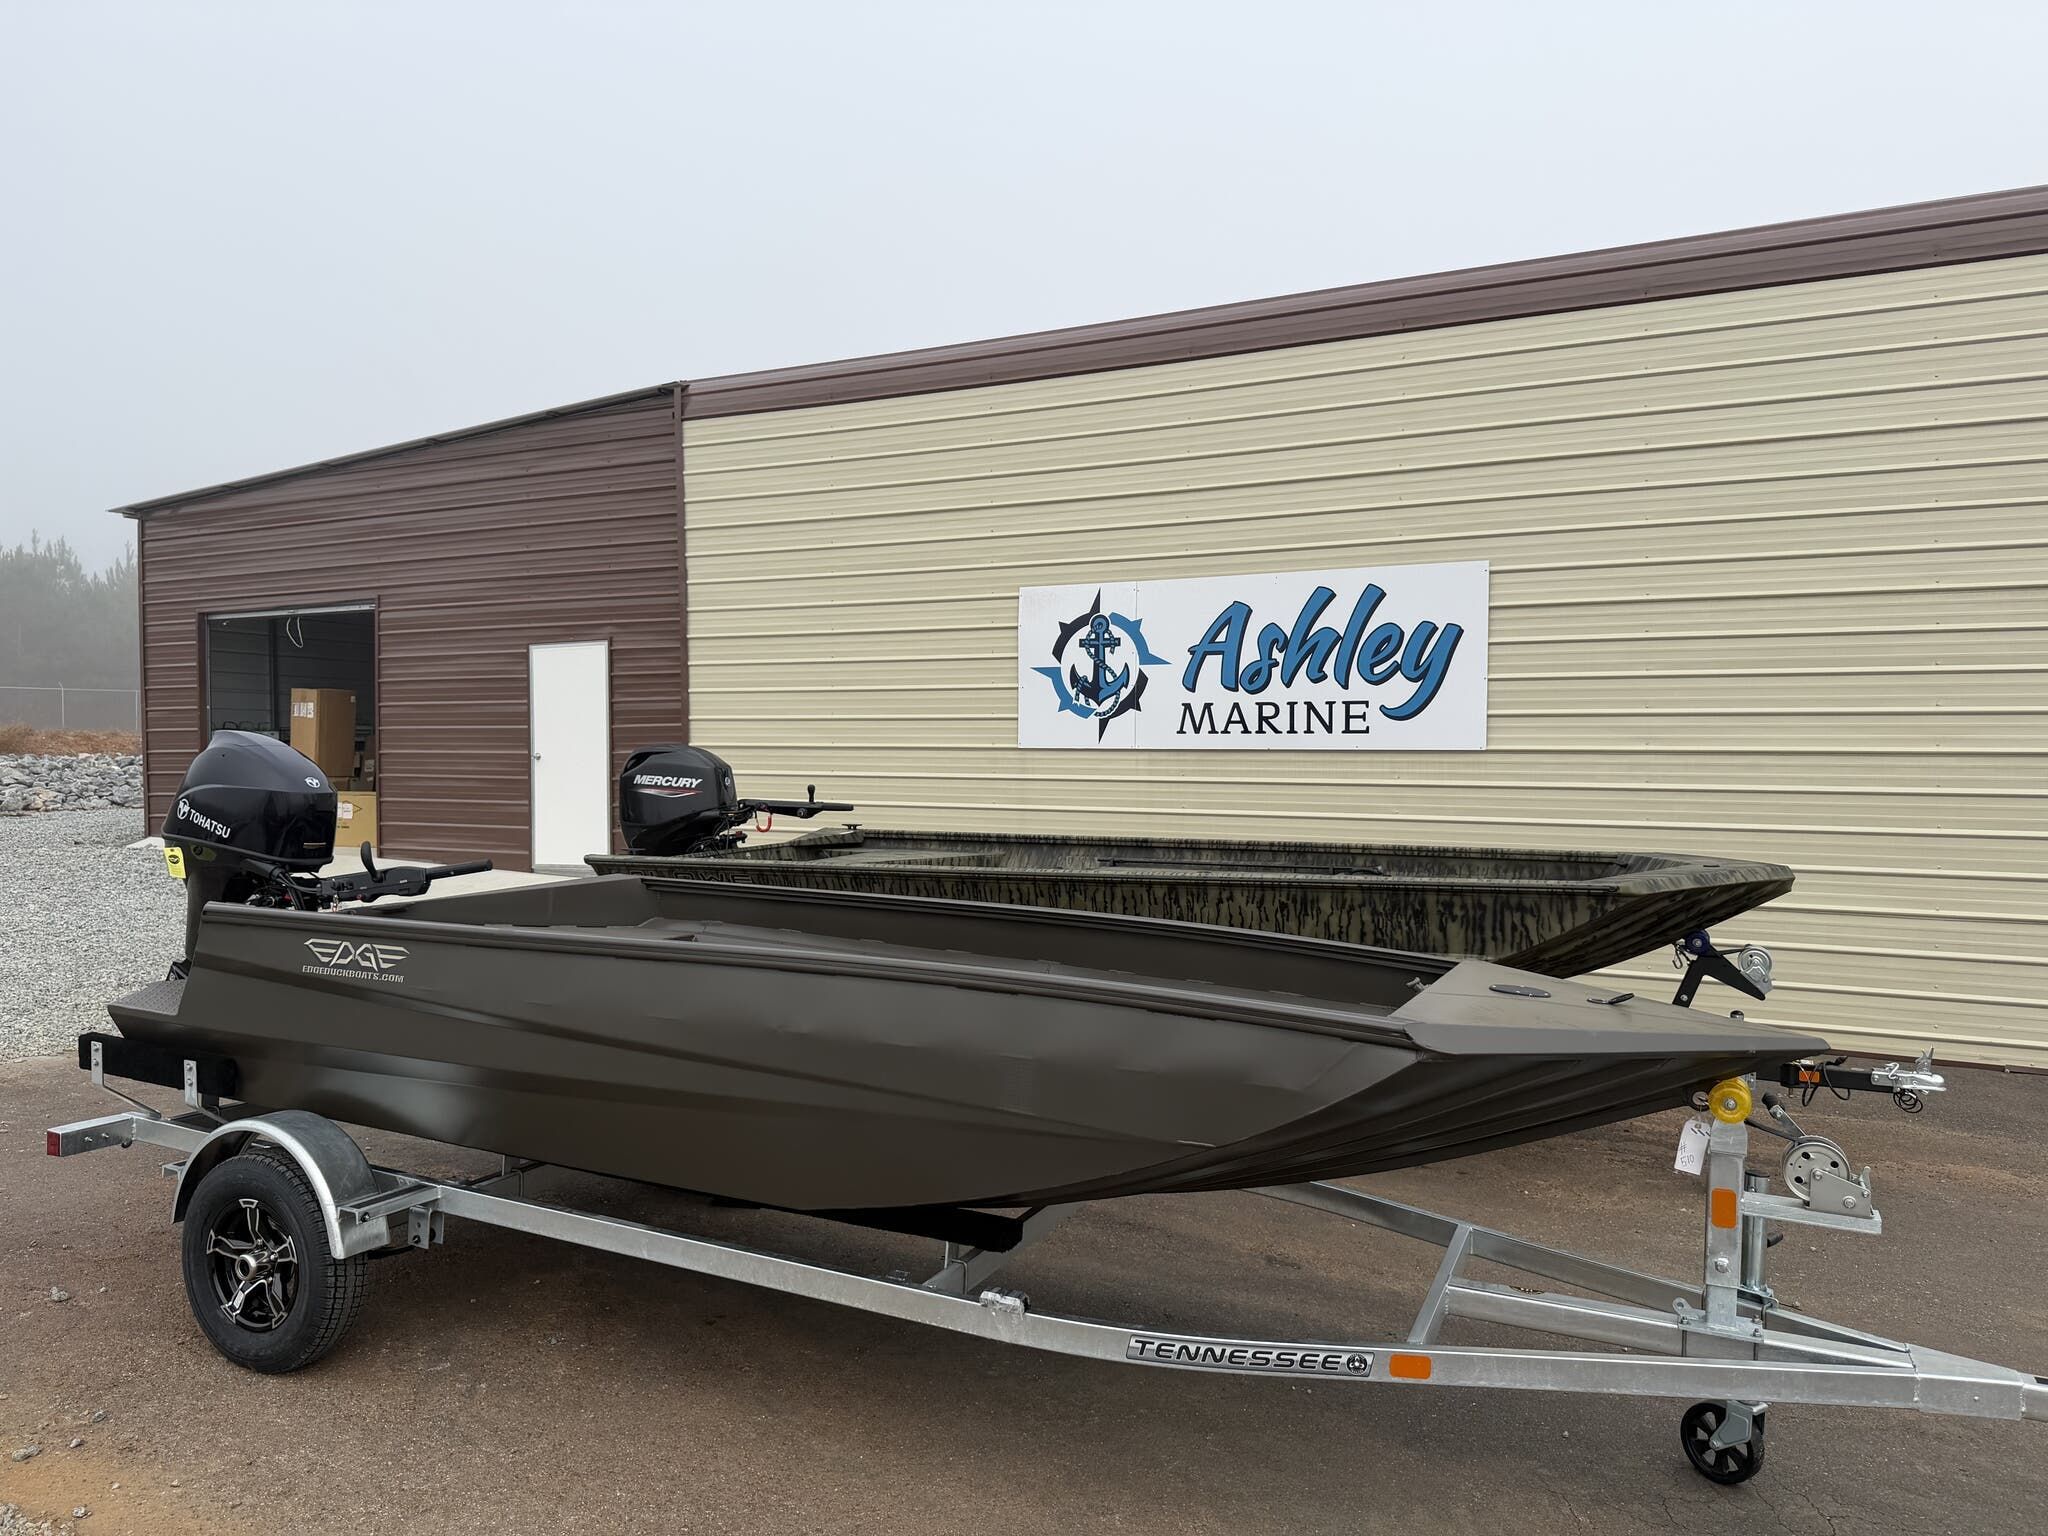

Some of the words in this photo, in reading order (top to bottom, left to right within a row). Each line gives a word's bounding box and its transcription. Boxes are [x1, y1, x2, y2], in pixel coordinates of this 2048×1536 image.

[1181, 583, 1464, 721] Ashley
[1176, 700, 1370, 734] MARINE
[633, 774, 703, 788] MERCURY
[189, 808, 231, 839] TOHATSU
[302, 965, 405, 983] EDGEDUCKBOATS.COM
[1134, 1339, 1342, 1371] TENNESSEE
